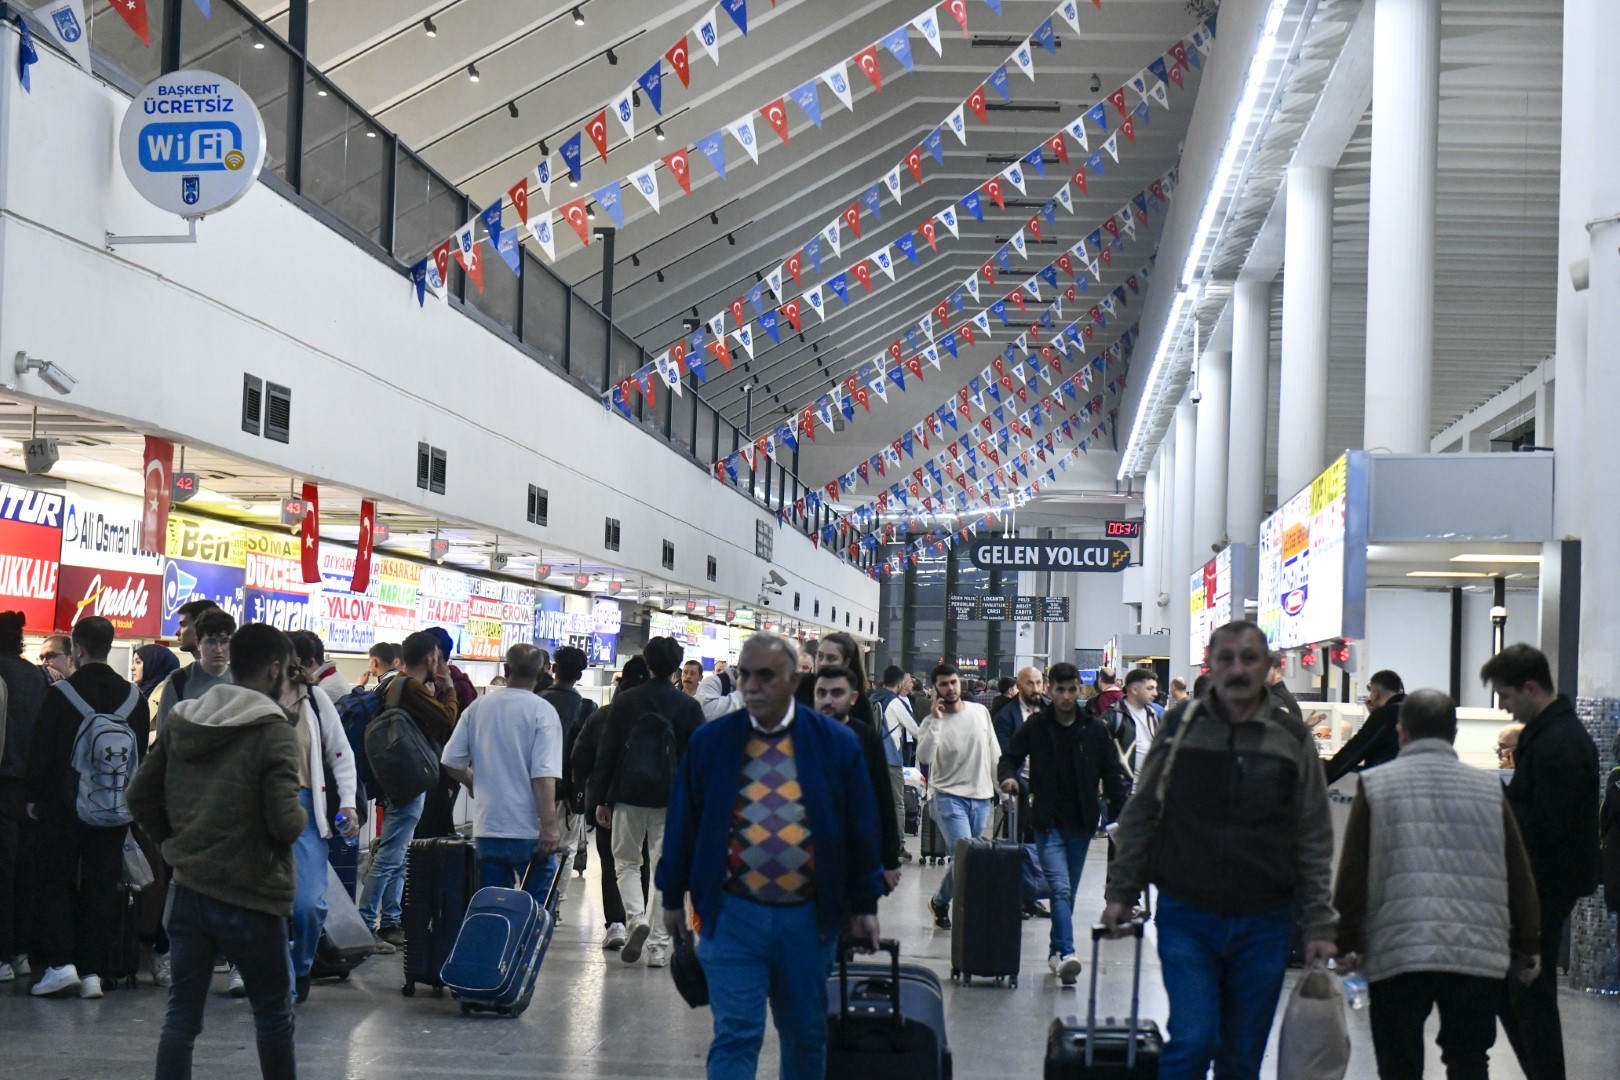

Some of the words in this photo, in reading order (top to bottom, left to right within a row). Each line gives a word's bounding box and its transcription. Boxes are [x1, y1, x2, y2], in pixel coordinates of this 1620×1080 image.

[158, 84, 220, 98] BAŞKENT
[144, 95, 234, 115] ÜCRETSİZ
[147, 132, 222, 162] WiFi
[28, 443, 44, 457] 41
[176, 477, 193, 490] 42
[286, 503, 301, 514] 43
[80, 511, 94, 550] Ali
[95, 513, 130, 554] Osman
[1107, 522, 1139, 535] 00:31
[248, 534, 291, 556] SOMA
[434, 541, 447, 551] 45
[494, 555, 505, 564] 46
[978, 545, 1039, 565] GELEN
[1045, 546, 1109, 566] YOLCU
[246, 553, 291, 591] DÜZCE
[538, 566, 549, 575] 47
[427, 598, 461, 623] HAZAR
[328, 622, 350, 642] Mersin
[468, 638, 500, 657] Süha
